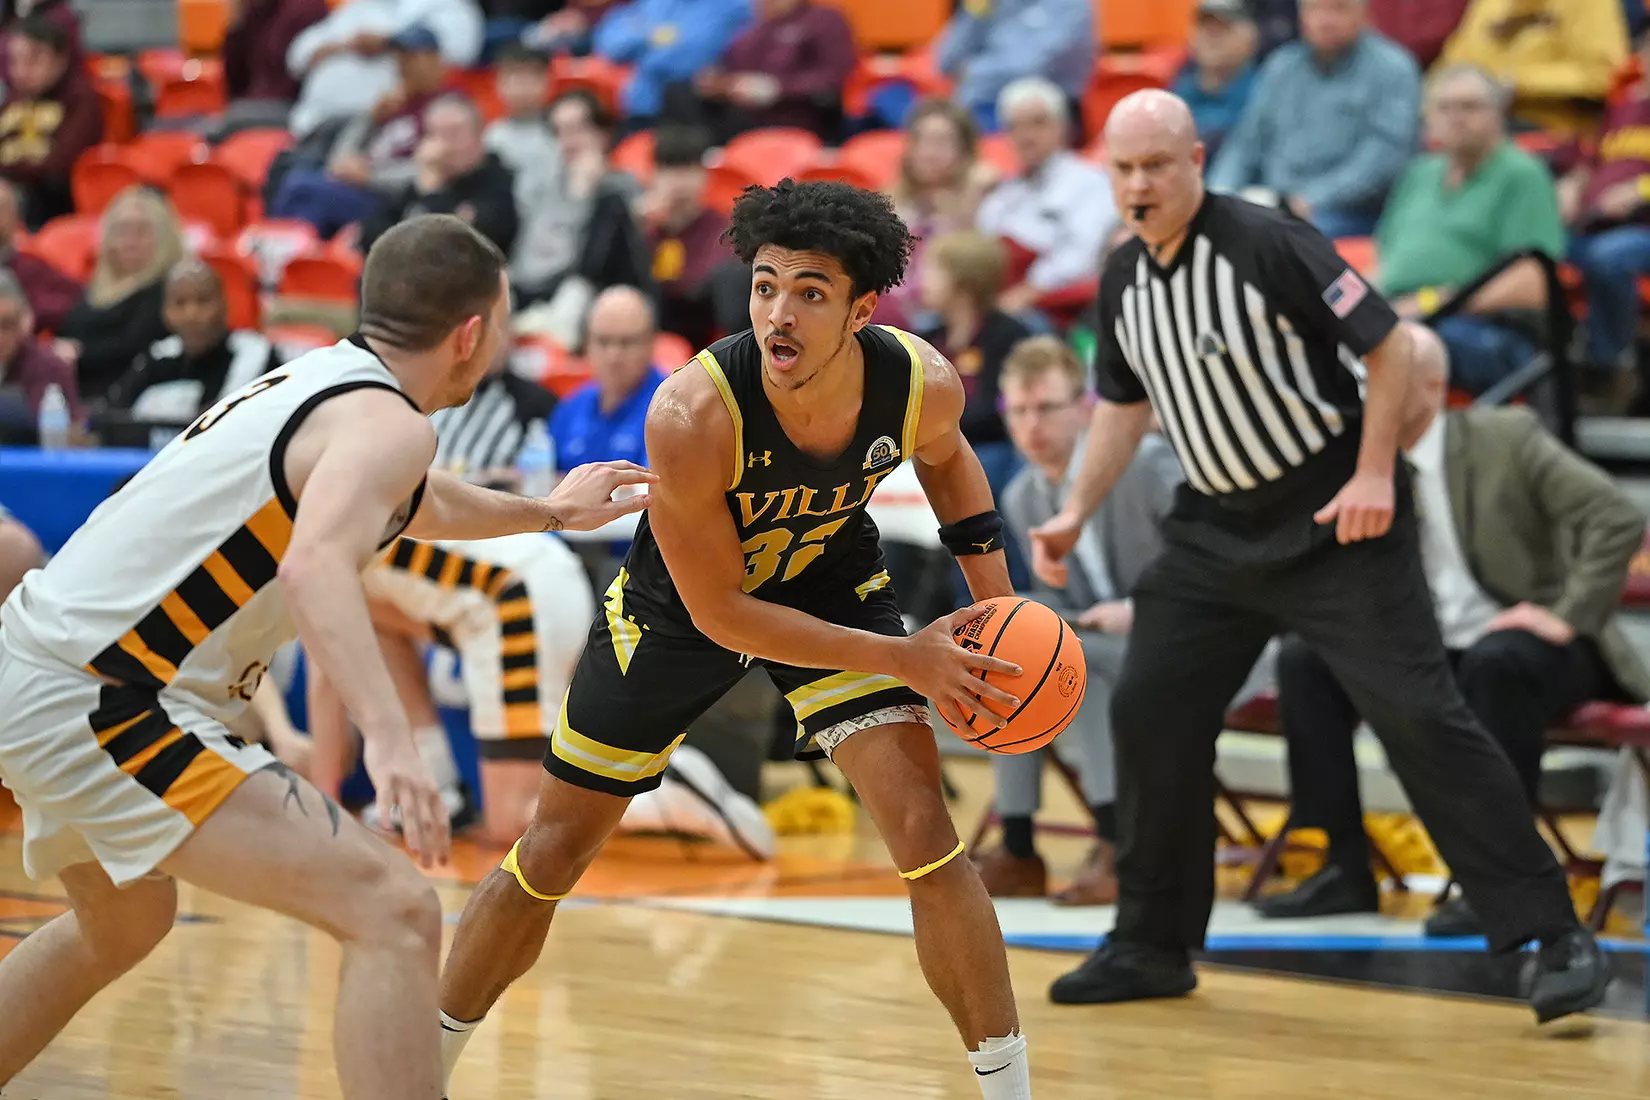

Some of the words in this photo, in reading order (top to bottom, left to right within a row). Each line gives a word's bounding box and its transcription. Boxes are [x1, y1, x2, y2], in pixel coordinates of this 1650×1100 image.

[183, 373, 292, 443] 3
[873, 445, 889, 460] 50
[741, 516, 850, 594] 32
